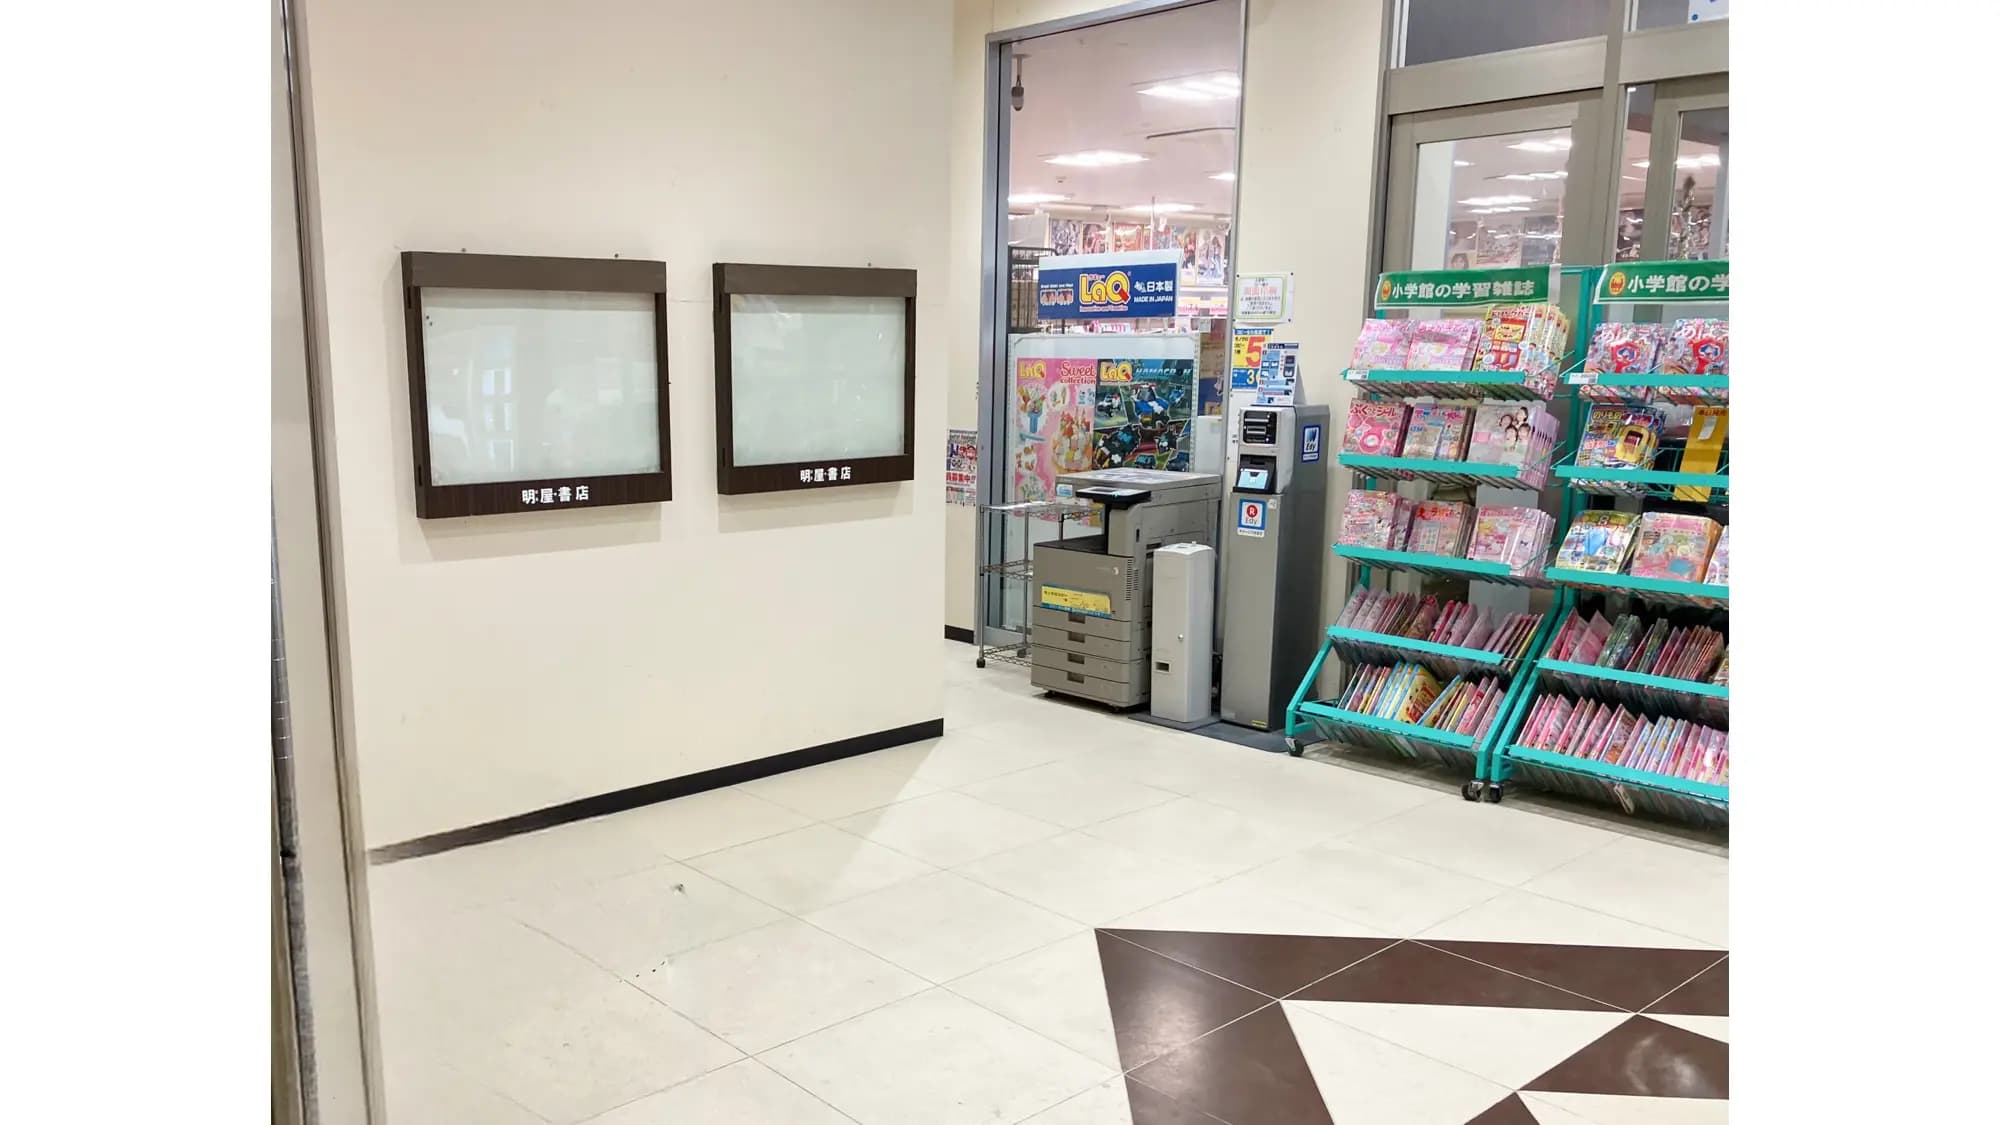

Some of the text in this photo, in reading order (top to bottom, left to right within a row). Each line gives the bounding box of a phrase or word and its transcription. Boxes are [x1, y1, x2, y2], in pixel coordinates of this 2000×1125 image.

[1079, 270, 1131, 305] LaQ
[1146, 280, 1173, 292] 日本製
[1391, 279, 1535, 299] 小学館の学習雑誌
[1019, 360, 1096, 379] LaQ Sweet
[1101, 361, 1133, 382] LaQ
[1060, 376, 1096, 385] collection
[1305, 442, 1317, 452] Edy
[800, 466, 851, 483] 明屋書店
[521, 485, 590, 505] 明屋書店
[1245, 518, 1258, 526] Edy
